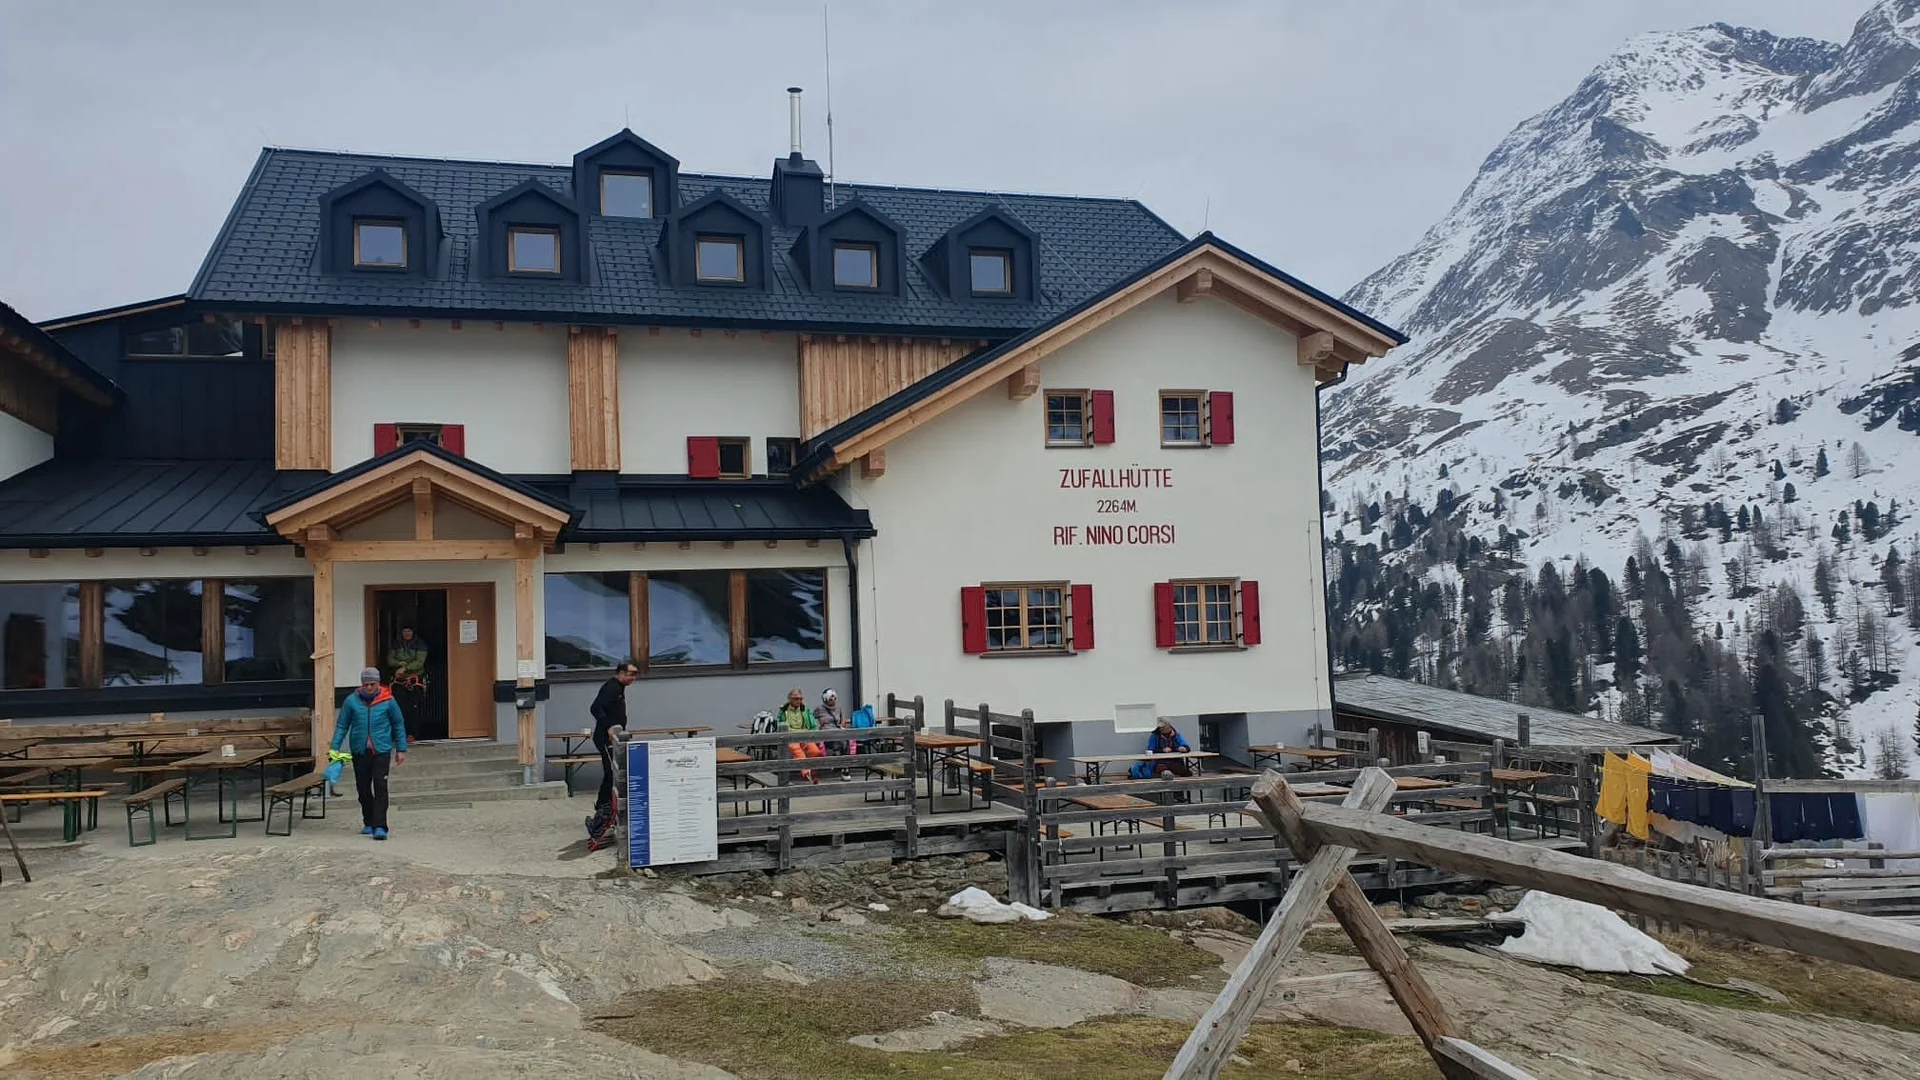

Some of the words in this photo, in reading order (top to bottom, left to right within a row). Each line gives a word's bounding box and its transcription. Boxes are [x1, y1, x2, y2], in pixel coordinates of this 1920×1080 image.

[1059, 463, 1173, 488] ZUFALLHÜTTE
[1097, 499, 1138, 513] 2264M.
[1054, 526, 1083, 545] RIF.
[1086, 525, 1123, 545] NINO
[1127, 524, 1175, 545] CORSI
